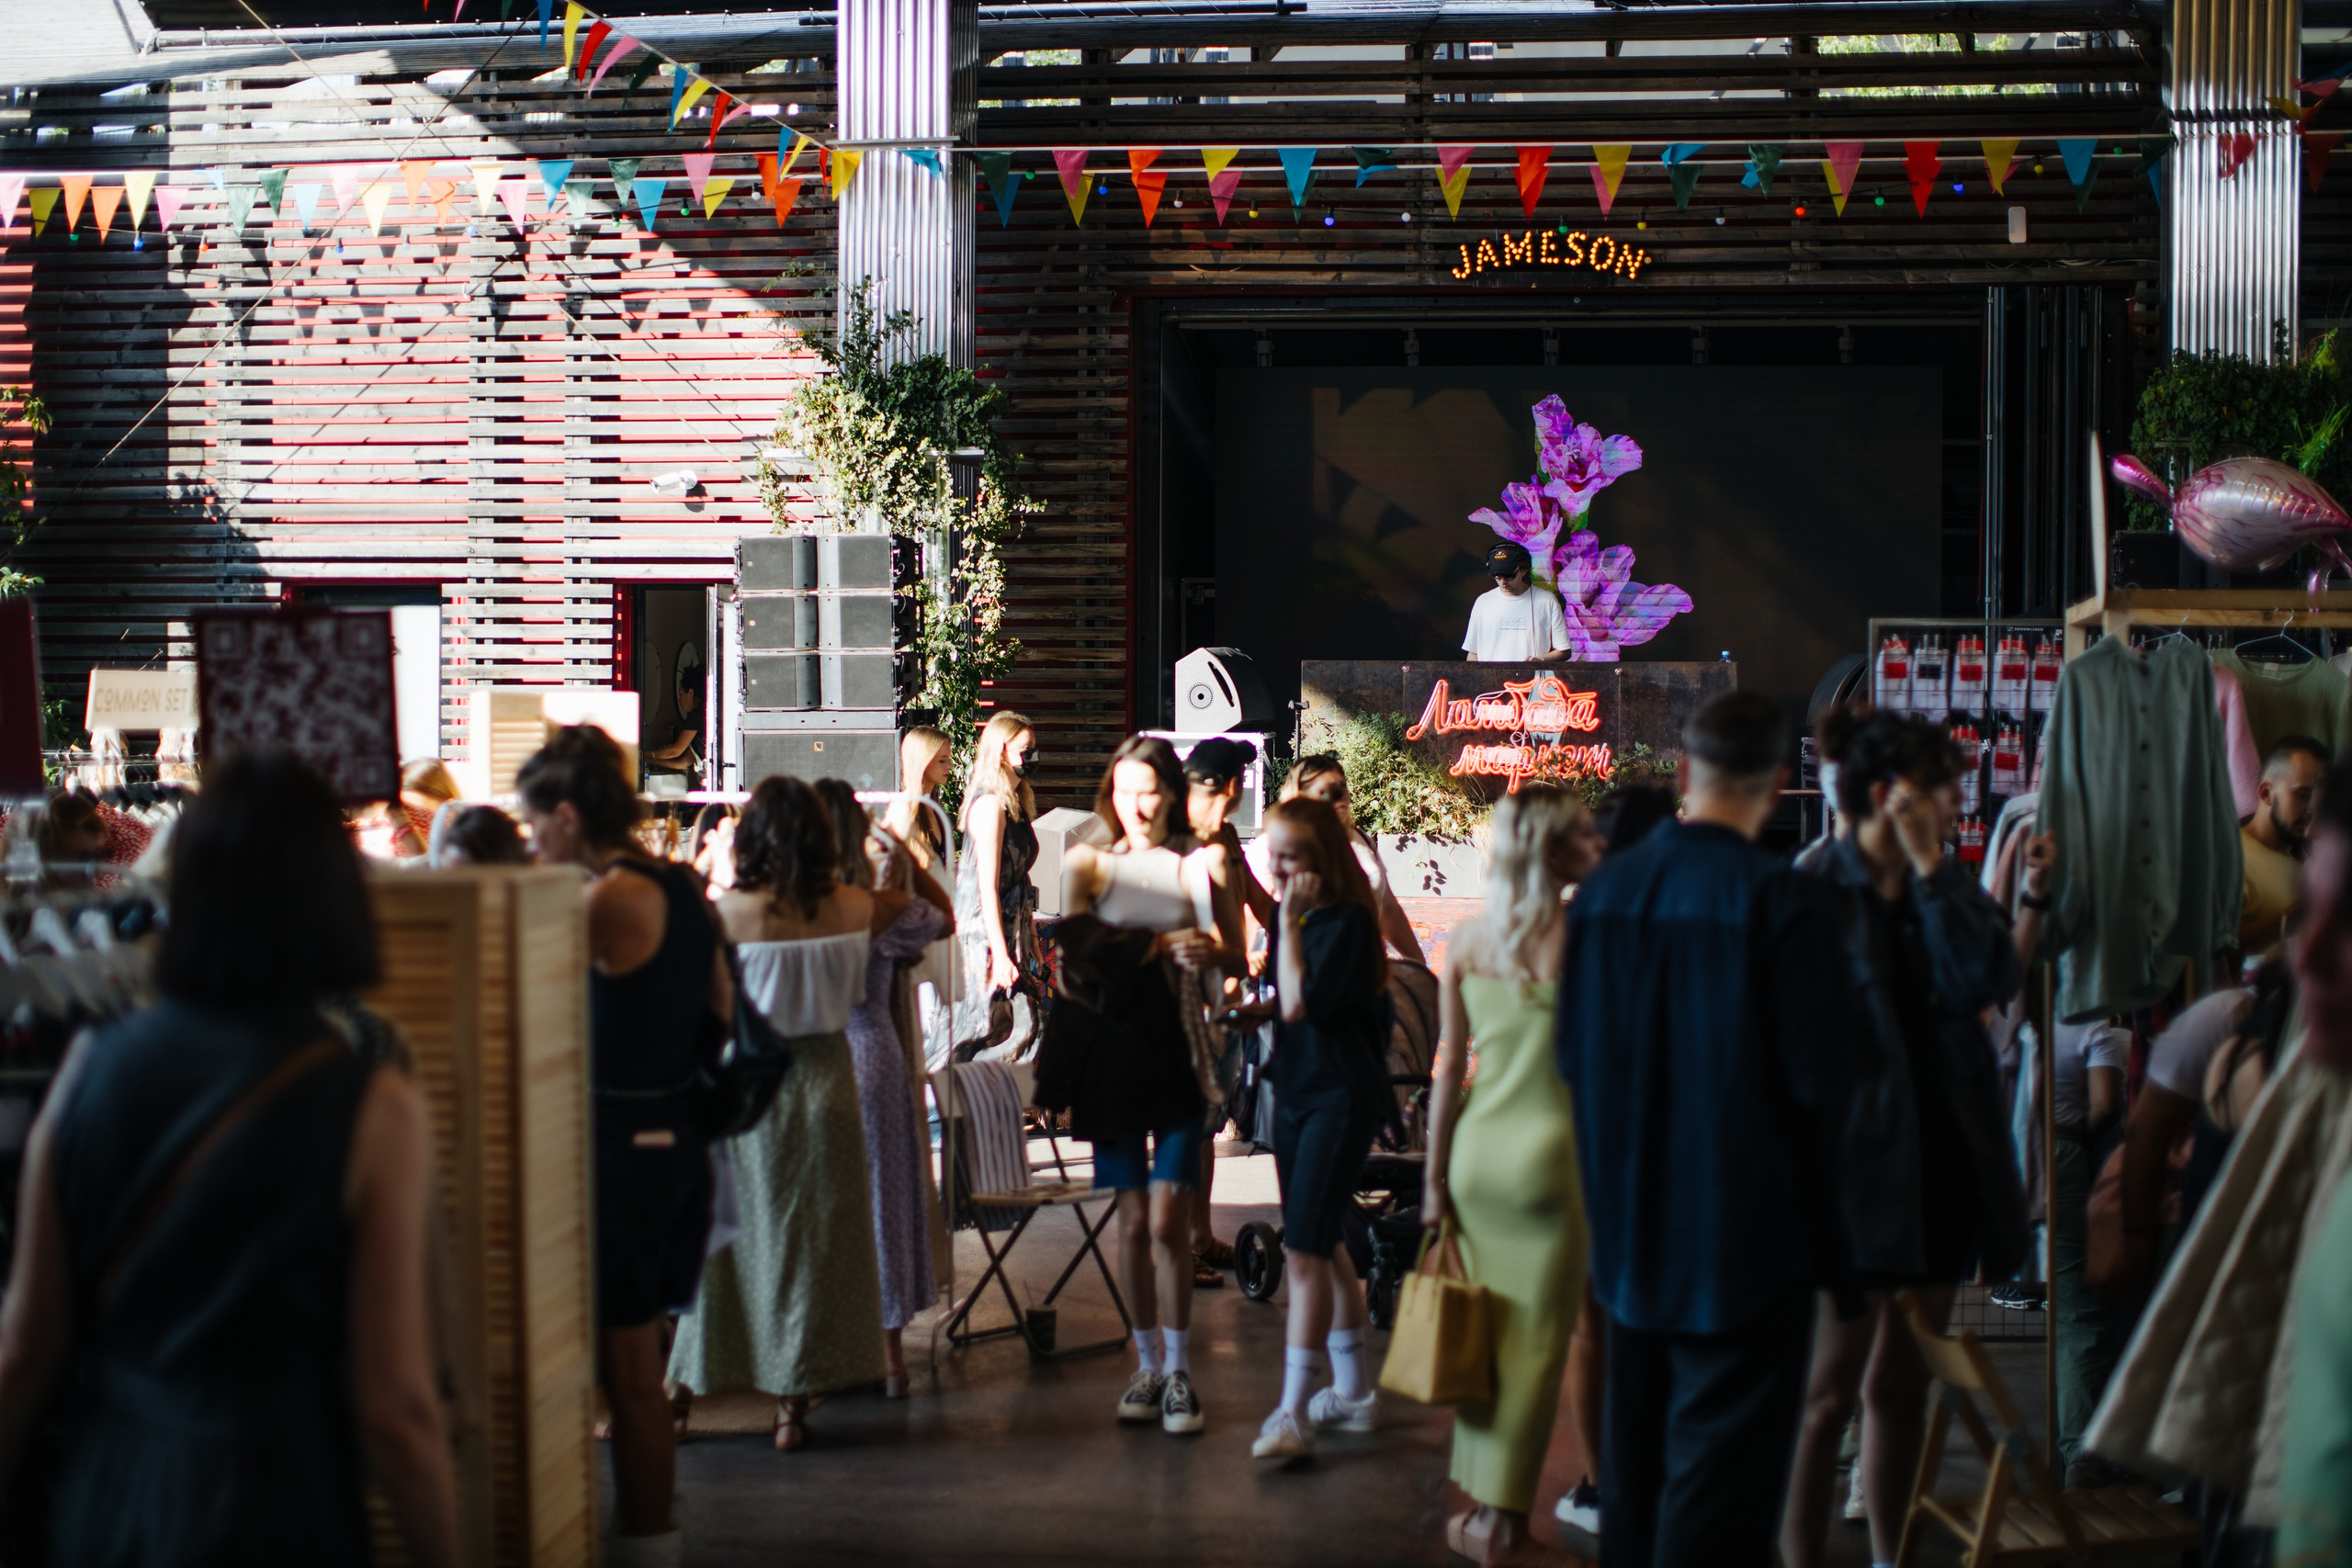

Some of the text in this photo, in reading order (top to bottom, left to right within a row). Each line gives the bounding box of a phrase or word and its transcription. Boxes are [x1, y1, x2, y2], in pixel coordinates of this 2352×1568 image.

[1452, 231, 1645, 278] JAMESON
[94, 688, 187, 713] COMMON SET
